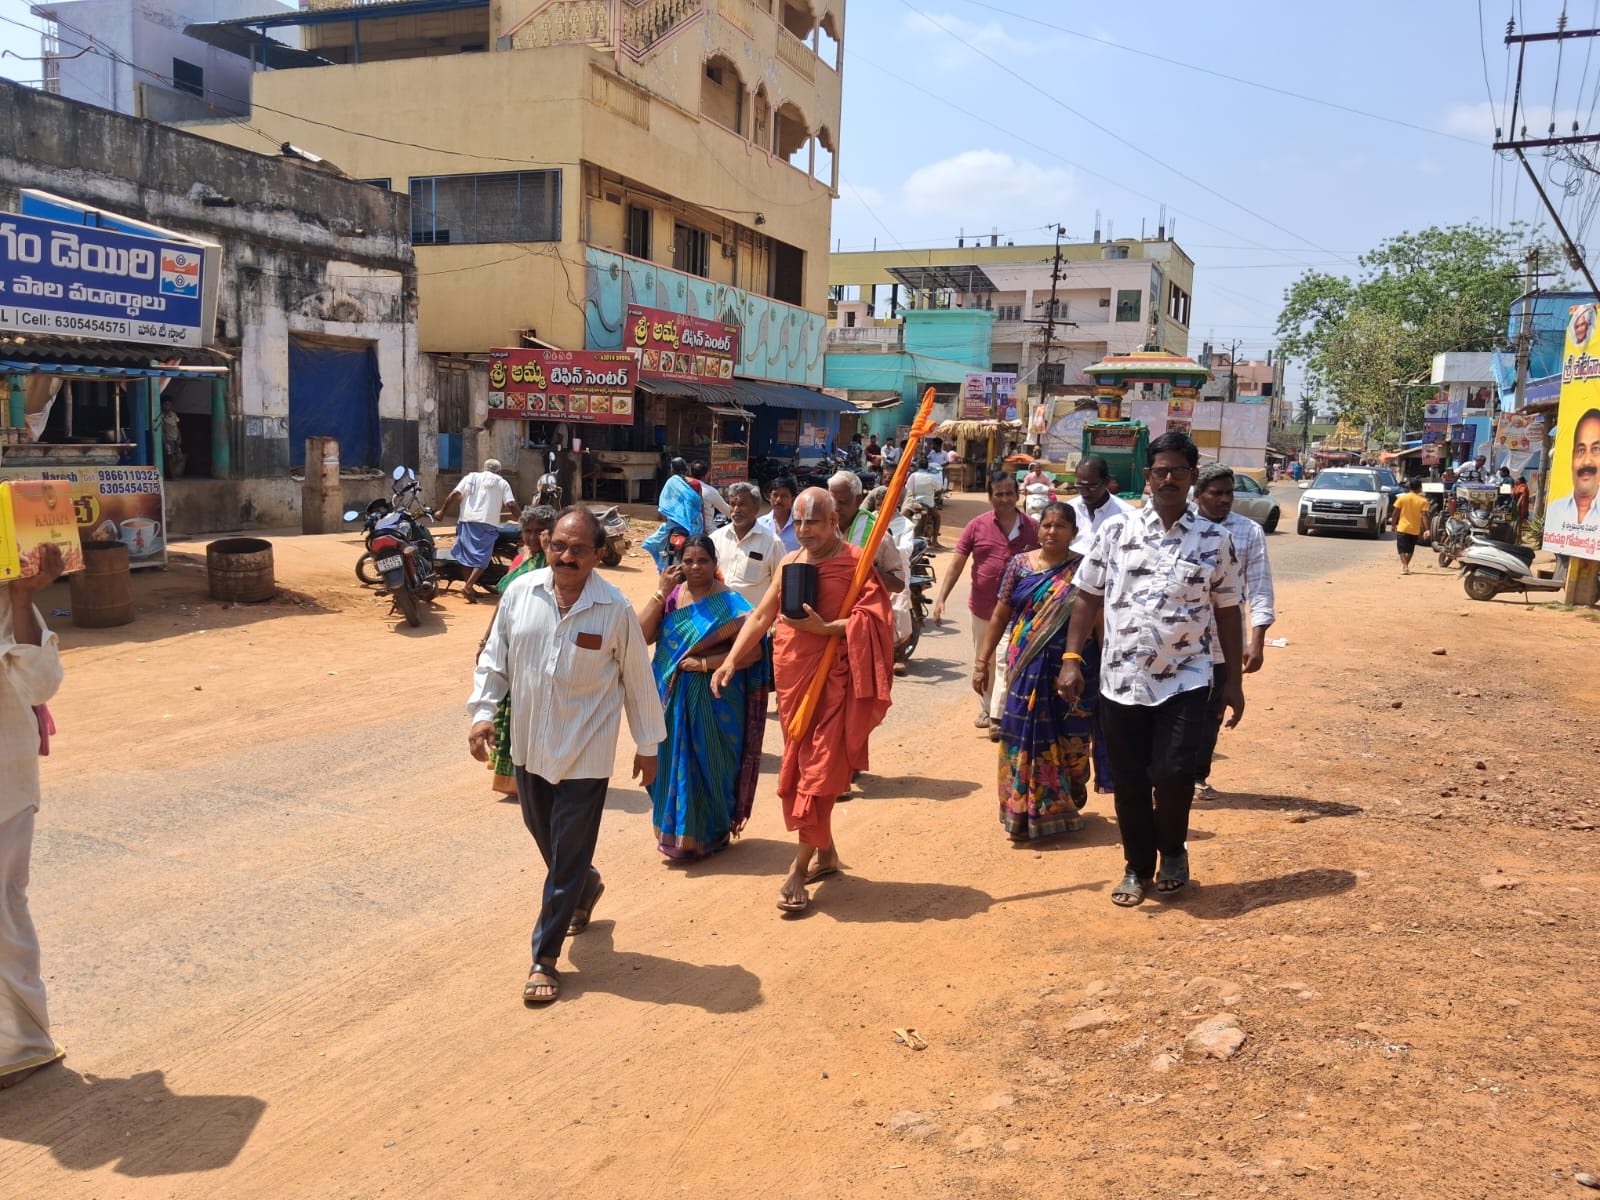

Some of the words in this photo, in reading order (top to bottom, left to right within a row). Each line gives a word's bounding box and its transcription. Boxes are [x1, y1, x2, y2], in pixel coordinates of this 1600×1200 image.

[12, 274, 64, 298] పాల
[22, 312, 50, 327] Cell:
[55, 316, 126, 334] 6305454575
[634, 316, 650, 346] శ్రీ
[652, 320, 679, 350] అమ్మ
[704, 333, 732, 351] సెంటర్
[490, 360, 508, 389] శ్రీ
[511, 360, 548, 390] అమ్మ
[585, 368, 628, 386] సెంటర్
[98, 470, 160, 482] 9866110325
[99, 483, 160, 495] 6305454575
